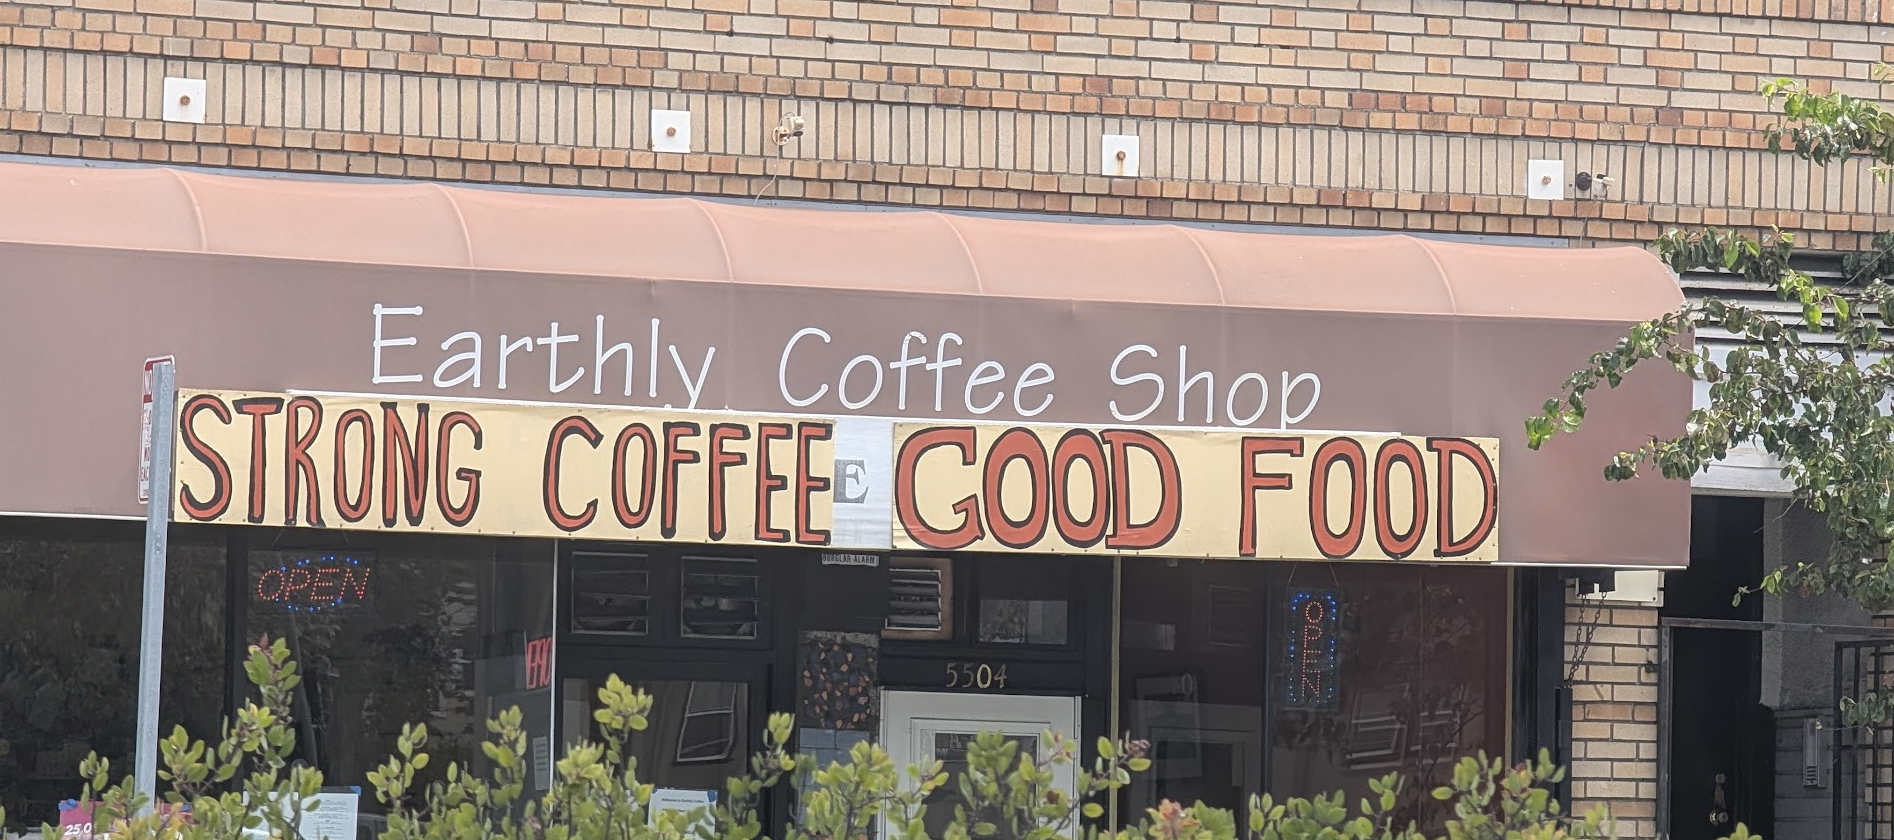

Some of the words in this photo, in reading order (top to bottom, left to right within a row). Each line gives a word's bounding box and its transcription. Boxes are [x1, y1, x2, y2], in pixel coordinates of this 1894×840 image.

[370, 303, 717, 408] Earthly
[778, 327, 1056, 412] Coffee
[1109, 344, 1322, 428] Shop
[179, 394, 483, 527] STRONG
[543, 417, 832, 546] COFFEE
[894, 427, 1182, 550] GOOD
[1238, 436, 1497, 558] FOOD
[257, 568, 370, 601] OPEN
[822, 553, 851, 563] BURGLAR
[853, 555, 875, 564] ALARM
[946, 662, 1007, 689] 5504
[1301, 600, 1323, 697] OPEN
